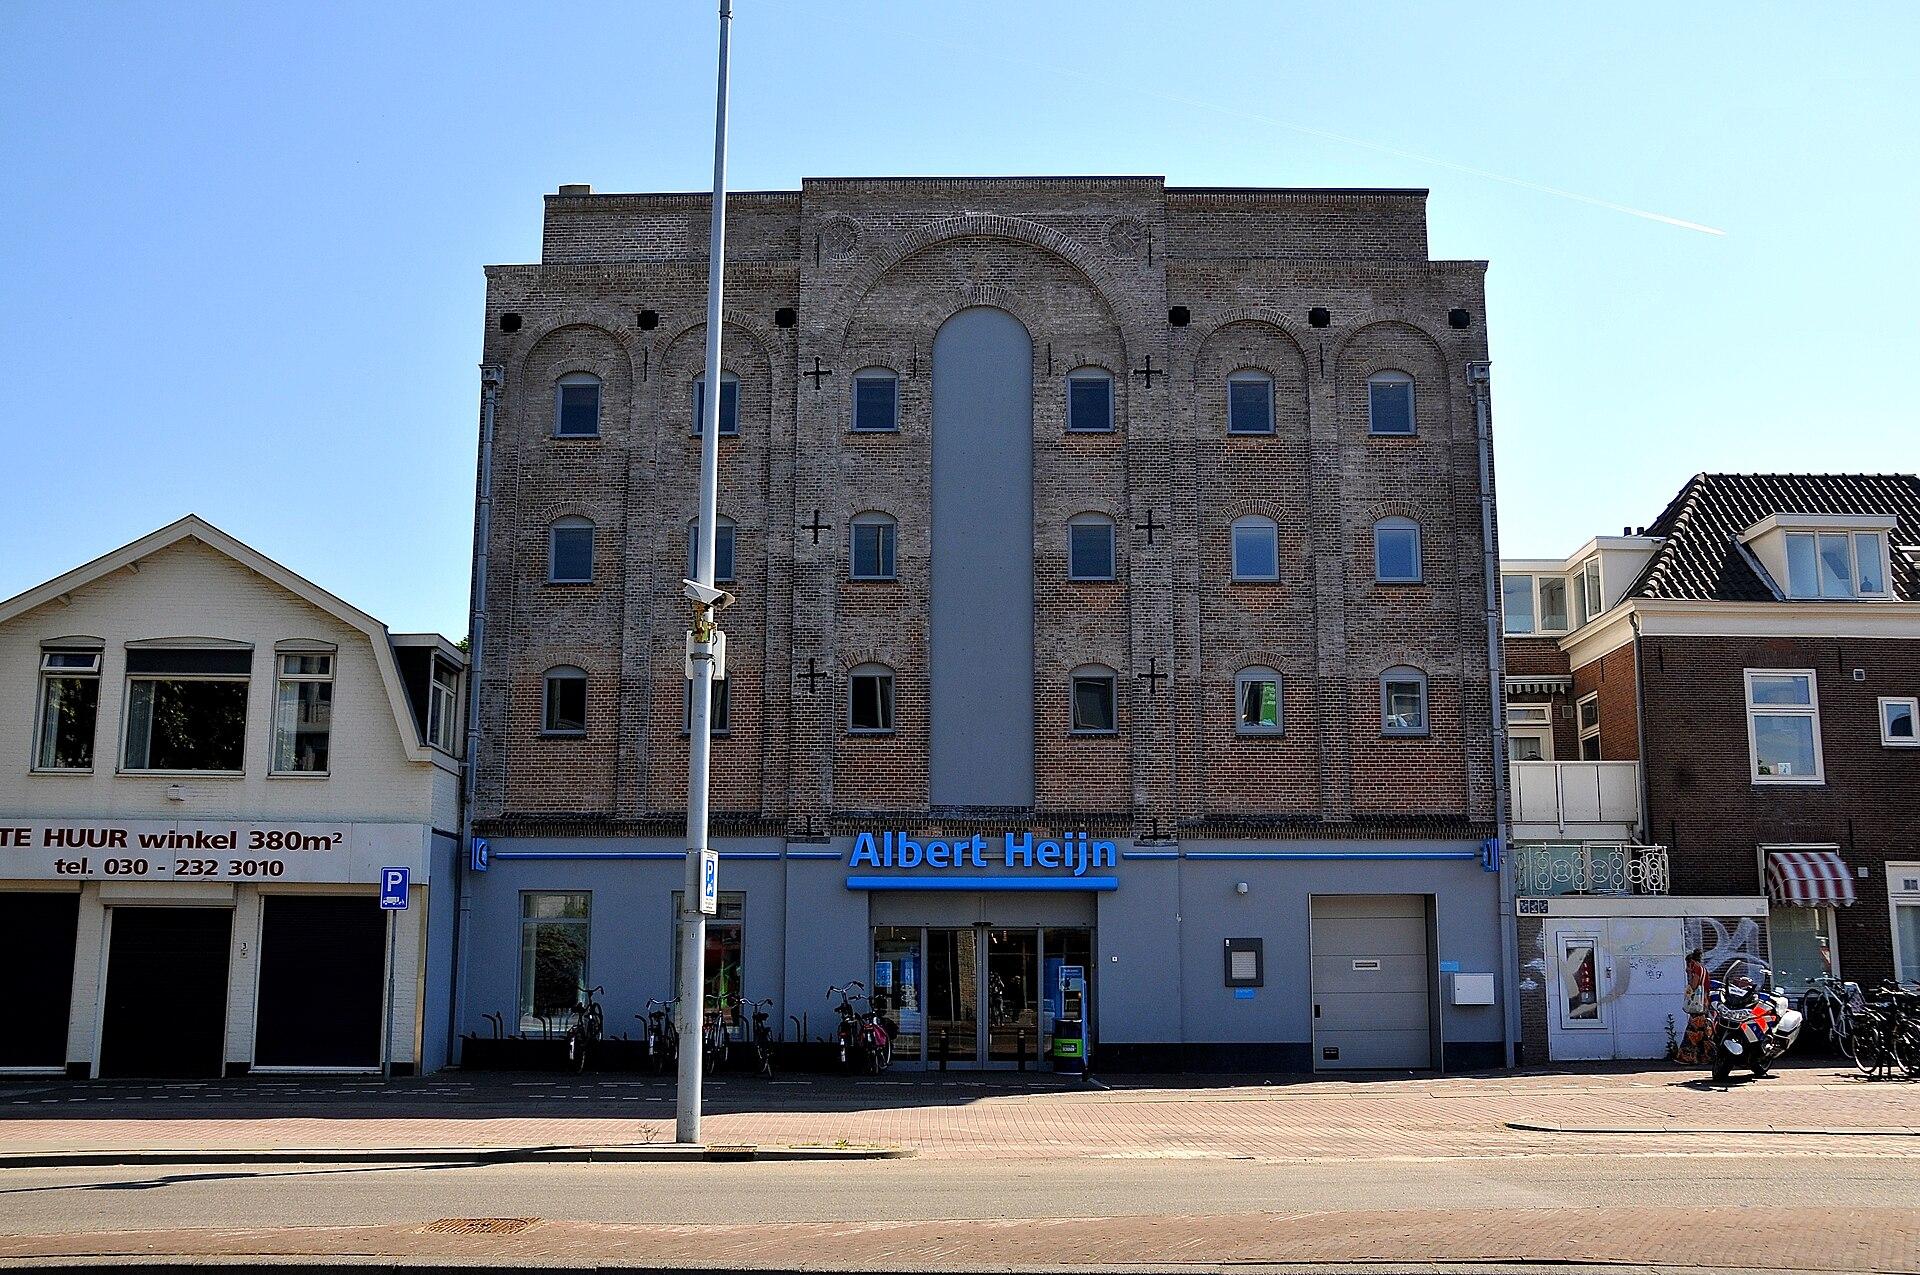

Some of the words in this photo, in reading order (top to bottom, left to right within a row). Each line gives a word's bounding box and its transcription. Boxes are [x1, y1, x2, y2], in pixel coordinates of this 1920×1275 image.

[0, 828, 32, 847] TE
[43, 828, 128, 848] HUUR
[137, 830, 237, 850] winkel
[848, 831, 988, 868] Albert
[1004, 832, 1117, 876] Heijn
[54, 857, 94, 875] tel.
[103, 858, 149, 876] 030
[174, 858, 219, 877] 232
[228, 859, 284, 877] 3010
[387, 871, 403, 892] P
